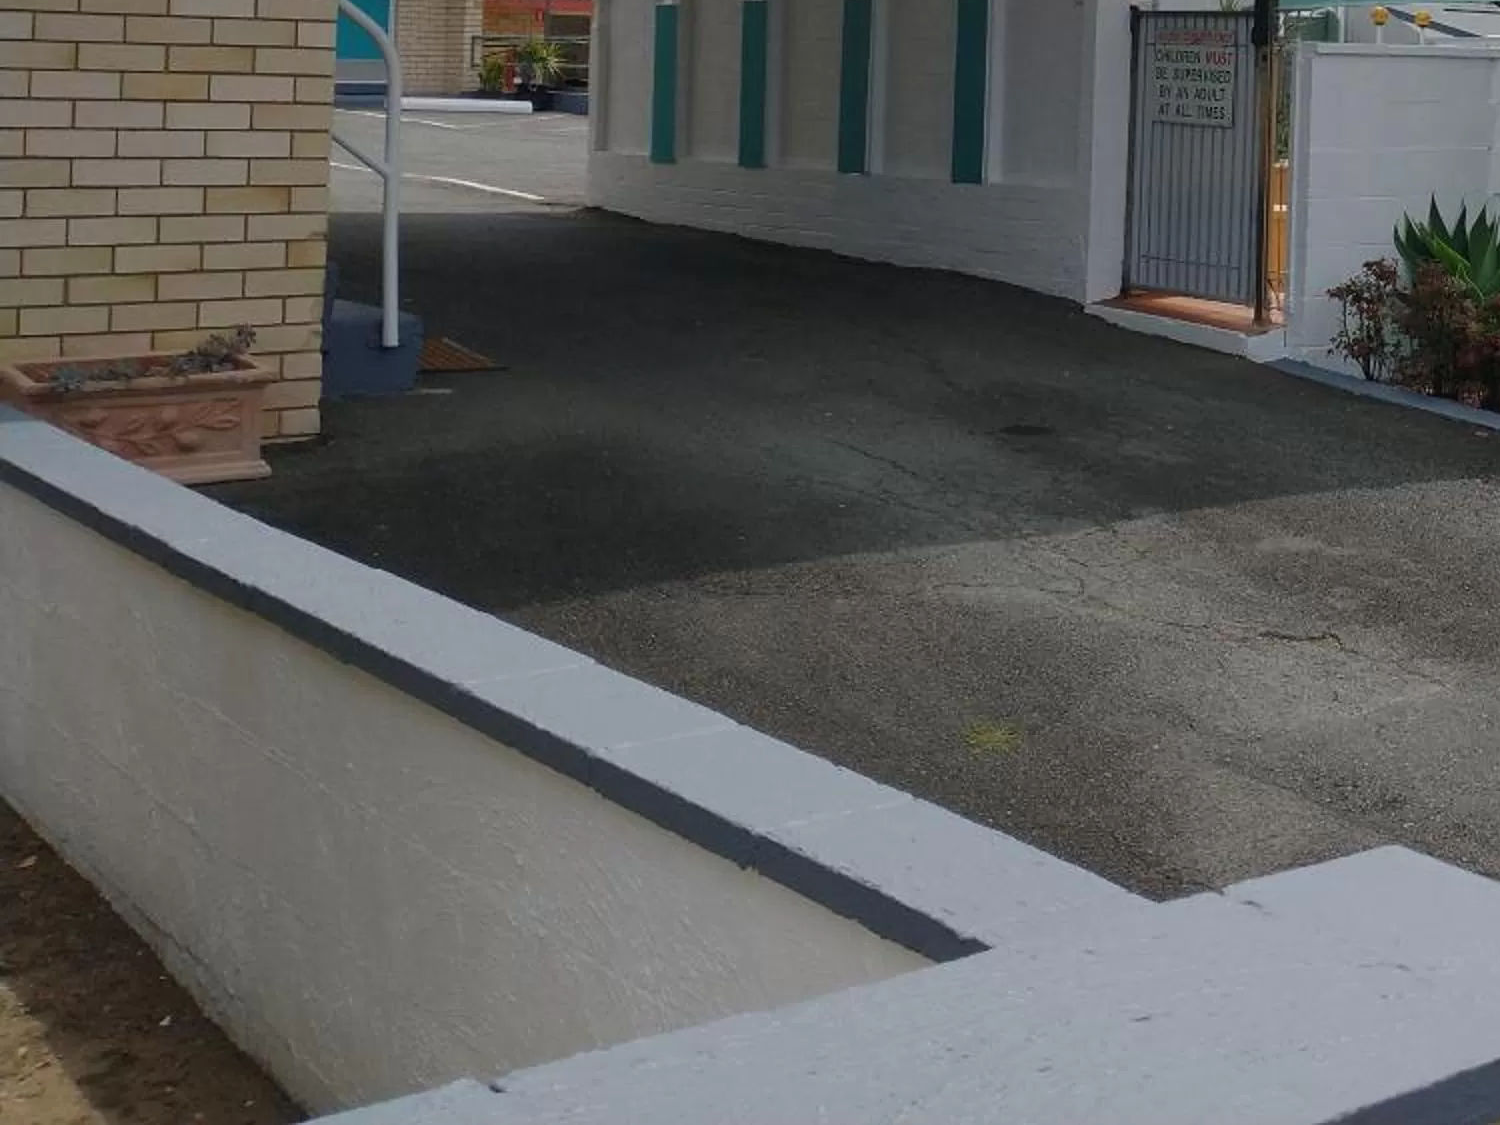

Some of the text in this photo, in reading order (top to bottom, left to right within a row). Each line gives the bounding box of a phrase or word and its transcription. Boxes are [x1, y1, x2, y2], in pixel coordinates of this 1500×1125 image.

[1206, 50, 1233, 66] MUST
[1155, 66, 1169, 80] BE
[1159, 84, 1226, 102] BY AN ADULT
[1158, 102, 1171, 116] AT
[1175, 103, 1193, 118] ALL
